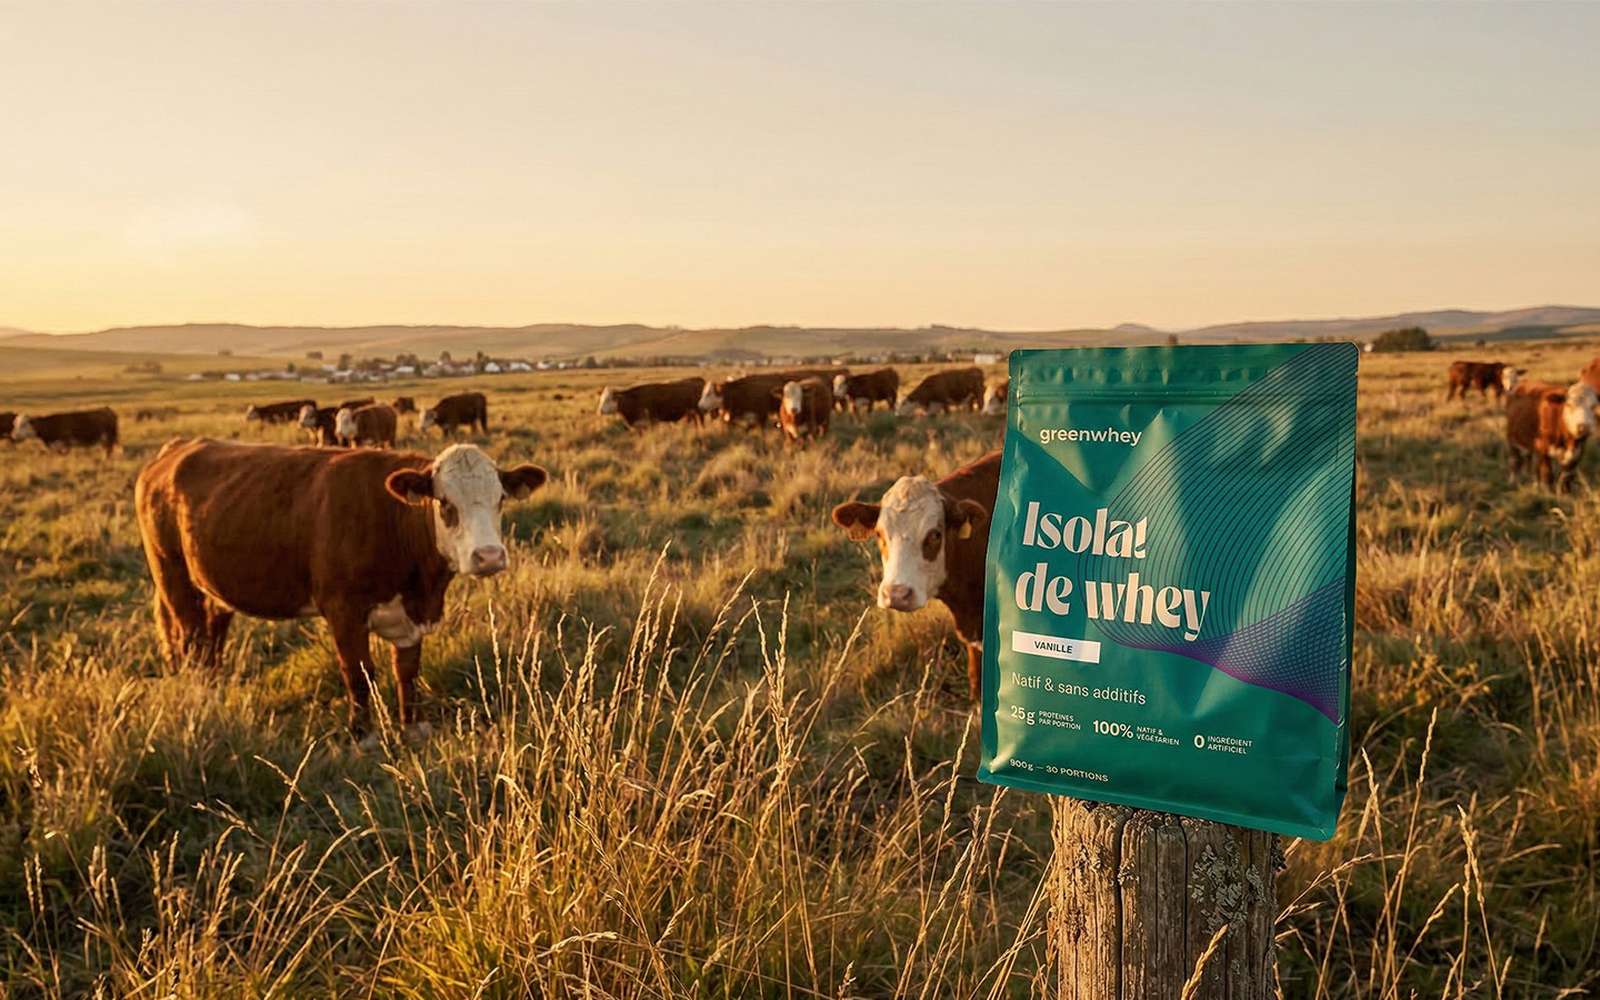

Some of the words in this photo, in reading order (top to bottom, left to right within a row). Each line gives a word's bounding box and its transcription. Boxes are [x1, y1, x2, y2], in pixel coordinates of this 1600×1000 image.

[1040, 428, 1142, 446] greenwhey
[1023, 501, 1147, 558] Isolat
[1015, 563, 1073, 615] de
[1085, 573, 1210, 641] whey
[1034, 641, 1073, 654] VANILLE
[1012, 672, 1041, 688] Natif
[1044, 678, 1054, 691] &
[1058, 682, 1089, 697] sans
[1093, 687, 1146, 705] additifs
[1010, 705, 1035, 725] 25g
[1052, 720, 1080, 730] PORTION
[1093, 720, 1134, 738] 100%
[1136, 726, 1156, 734] NATIF
[1194, 735, 1205, 748] 0
[1207, 744, 1247, 754] ARTIFICIEL
[1010, 759, 1034, 771] 900g
[1046, 765, 1058, 773] 30
[1060, 767, 1109, 782] PORTIONS
